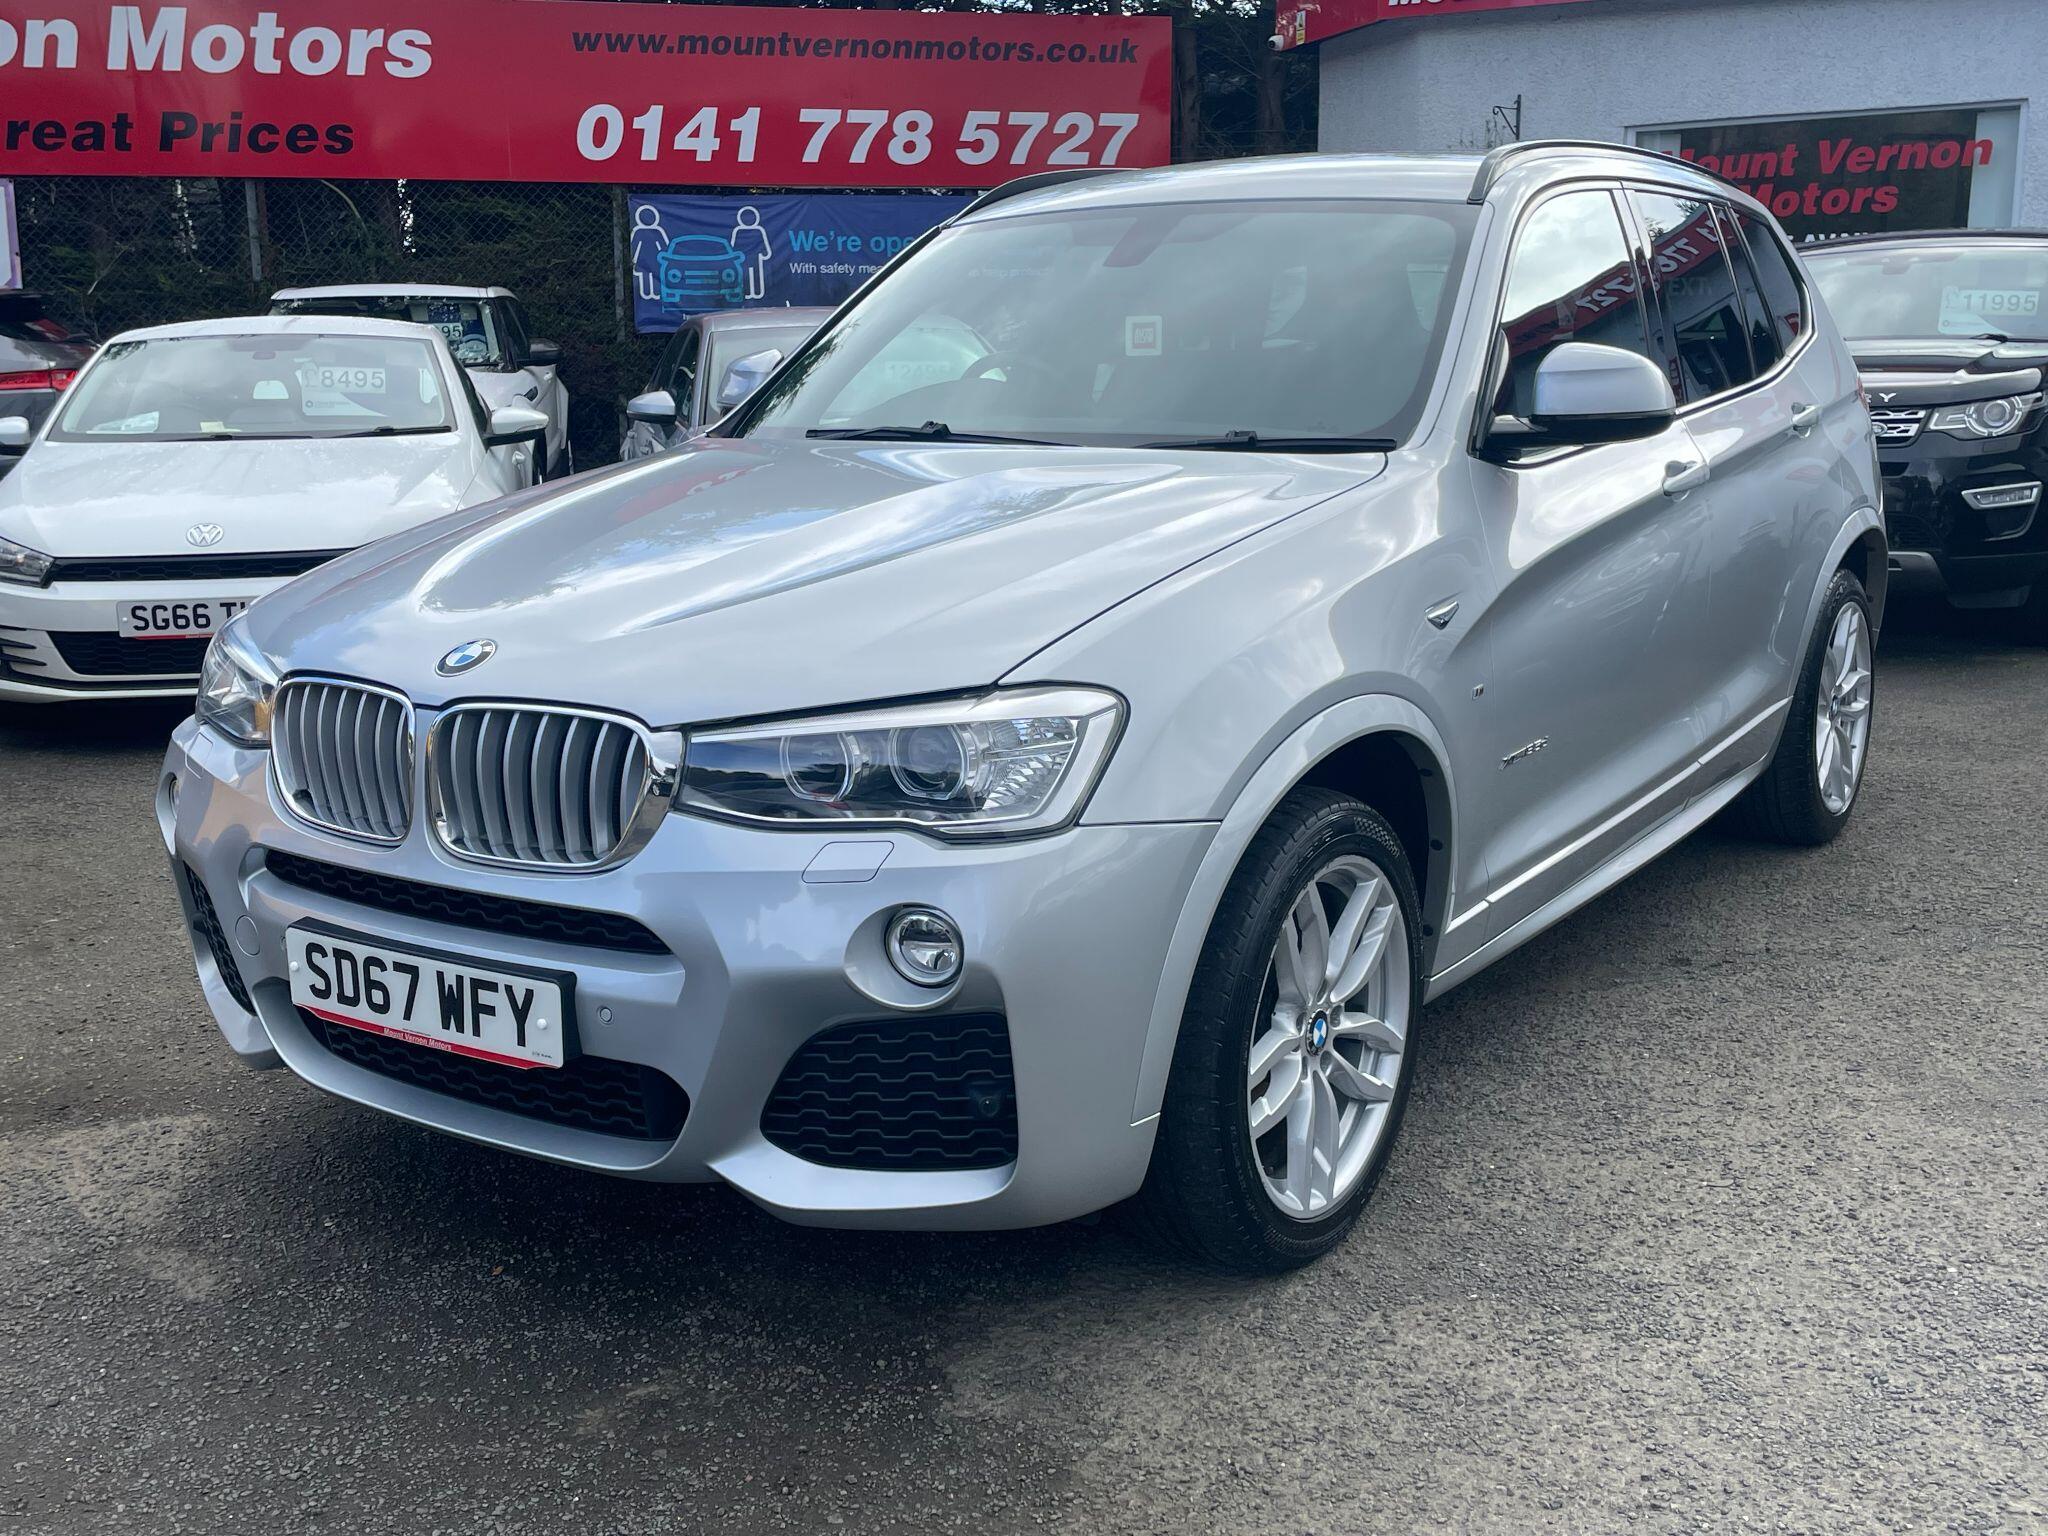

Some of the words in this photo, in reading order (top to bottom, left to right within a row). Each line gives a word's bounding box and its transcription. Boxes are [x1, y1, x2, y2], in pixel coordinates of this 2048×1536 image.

[106, 6, 432, 78] Motors
[572, 31, 1139, 64] www.mountvernonmotors.co.uk
[5, 112, 133, 152] reat
[159, 111, 354, 154] Prices
[576, 103, 761, 162] 0141
[799, 108, 932, 165] 778
[955, 110, 1140, 166] 5727
[1818, 138, 1994, 174] Vernon
[789, 262, 817, 275] With
[820, 262, 855, 279] safety
[131, 603, 211, 631] SG66
[220, 602, 246, 619] T
[305, 942, 420, 1021] SD67
[436, 970, 535, 1048] WFY
[383, 1027, 404, 1040] Mount
[405, 1033, 428, 1045] Vernon
[429, 1038, 452, 1051] Motors
